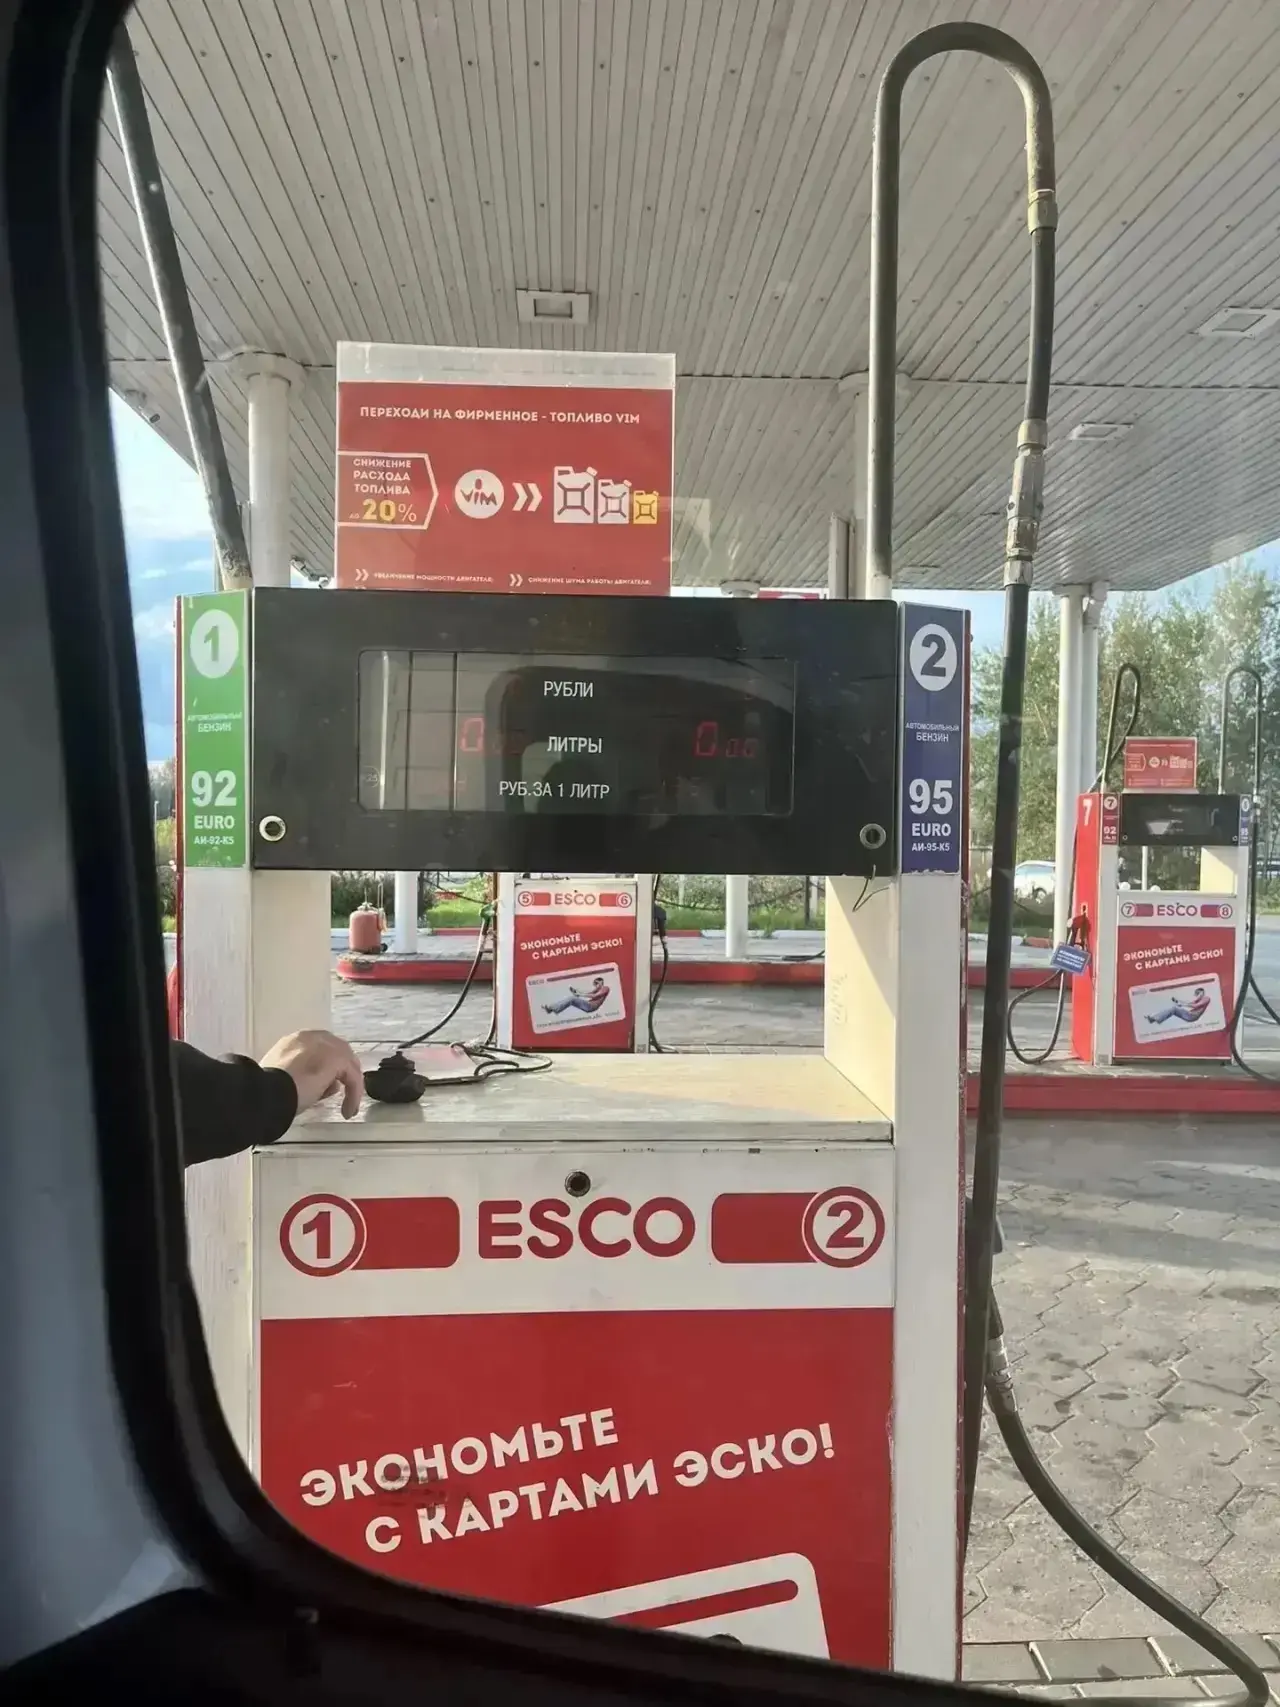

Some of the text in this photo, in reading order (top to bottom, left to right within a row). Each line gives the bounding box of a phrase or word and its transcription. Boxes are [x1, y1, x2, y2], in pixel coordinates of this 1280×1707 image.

[360, 406, 430, 419] ПЕРЕХОДИ
[433, 408, 452, 420] НА
[455, 409, 538, 422] ФИРМЕННОЕ
[549, 412, 612, 423] ТОПЛИВО
[616, 413, 640, 424] VIM
[353, 458, 412, 468] СНИЖЕНИЕ
[353, 470, 411, 481] РАСХОДА
[354, 483, 411, 495] ТОПЛИВА
[362, 498, 417, 522] 20%
[203, 625, 219, 662] 1
[920, 633, 947, 677] 2
[543, 680, 593, 698] РУБЛИ
[197, 722, 231, 733] БЕНЗИН
[905, 722, 960, 732] АВТОМОБИЛЬНЫЙ
[547, 736, 602, 753] ЛИТРЫ
[916, 732, 949, 742] БЕНЗИН
[191, 769, 237, 807] 92
[557, 783, 564, 798] 1
[570, 783, 610, 799] ЛИТР
[909, 778, 953, 815] 95
[1083, 798, 1093, 826] 7
[194, 815, 235, 830] EURO
[911, 822, 952, 837] EURO
[911, 842, 951, 852] АИ-95-К5
[522, 892, 628, 906] 5 ESCO 6
[1126, 904, 1229, 916] 7 ESCO 8
[520, 933, 581, 951] ЭКОНОМЬТЕ
[531, 937, 623, 960] С КАРТАМИ ЭСКО!
[1123, 944, 1183, 962] ЭКОНОМЬТЕ
[1134, 948, 1224, 971] С КАРТАМИ ЭСКО!
[301, 1196, 865, 1259] 1 ESCO 2
[299, 1407, 619, 1508] ЭКОНОМЬТЕ
[365, 1423, 836, 1553] С КАРТАМИ ЭСКО!
